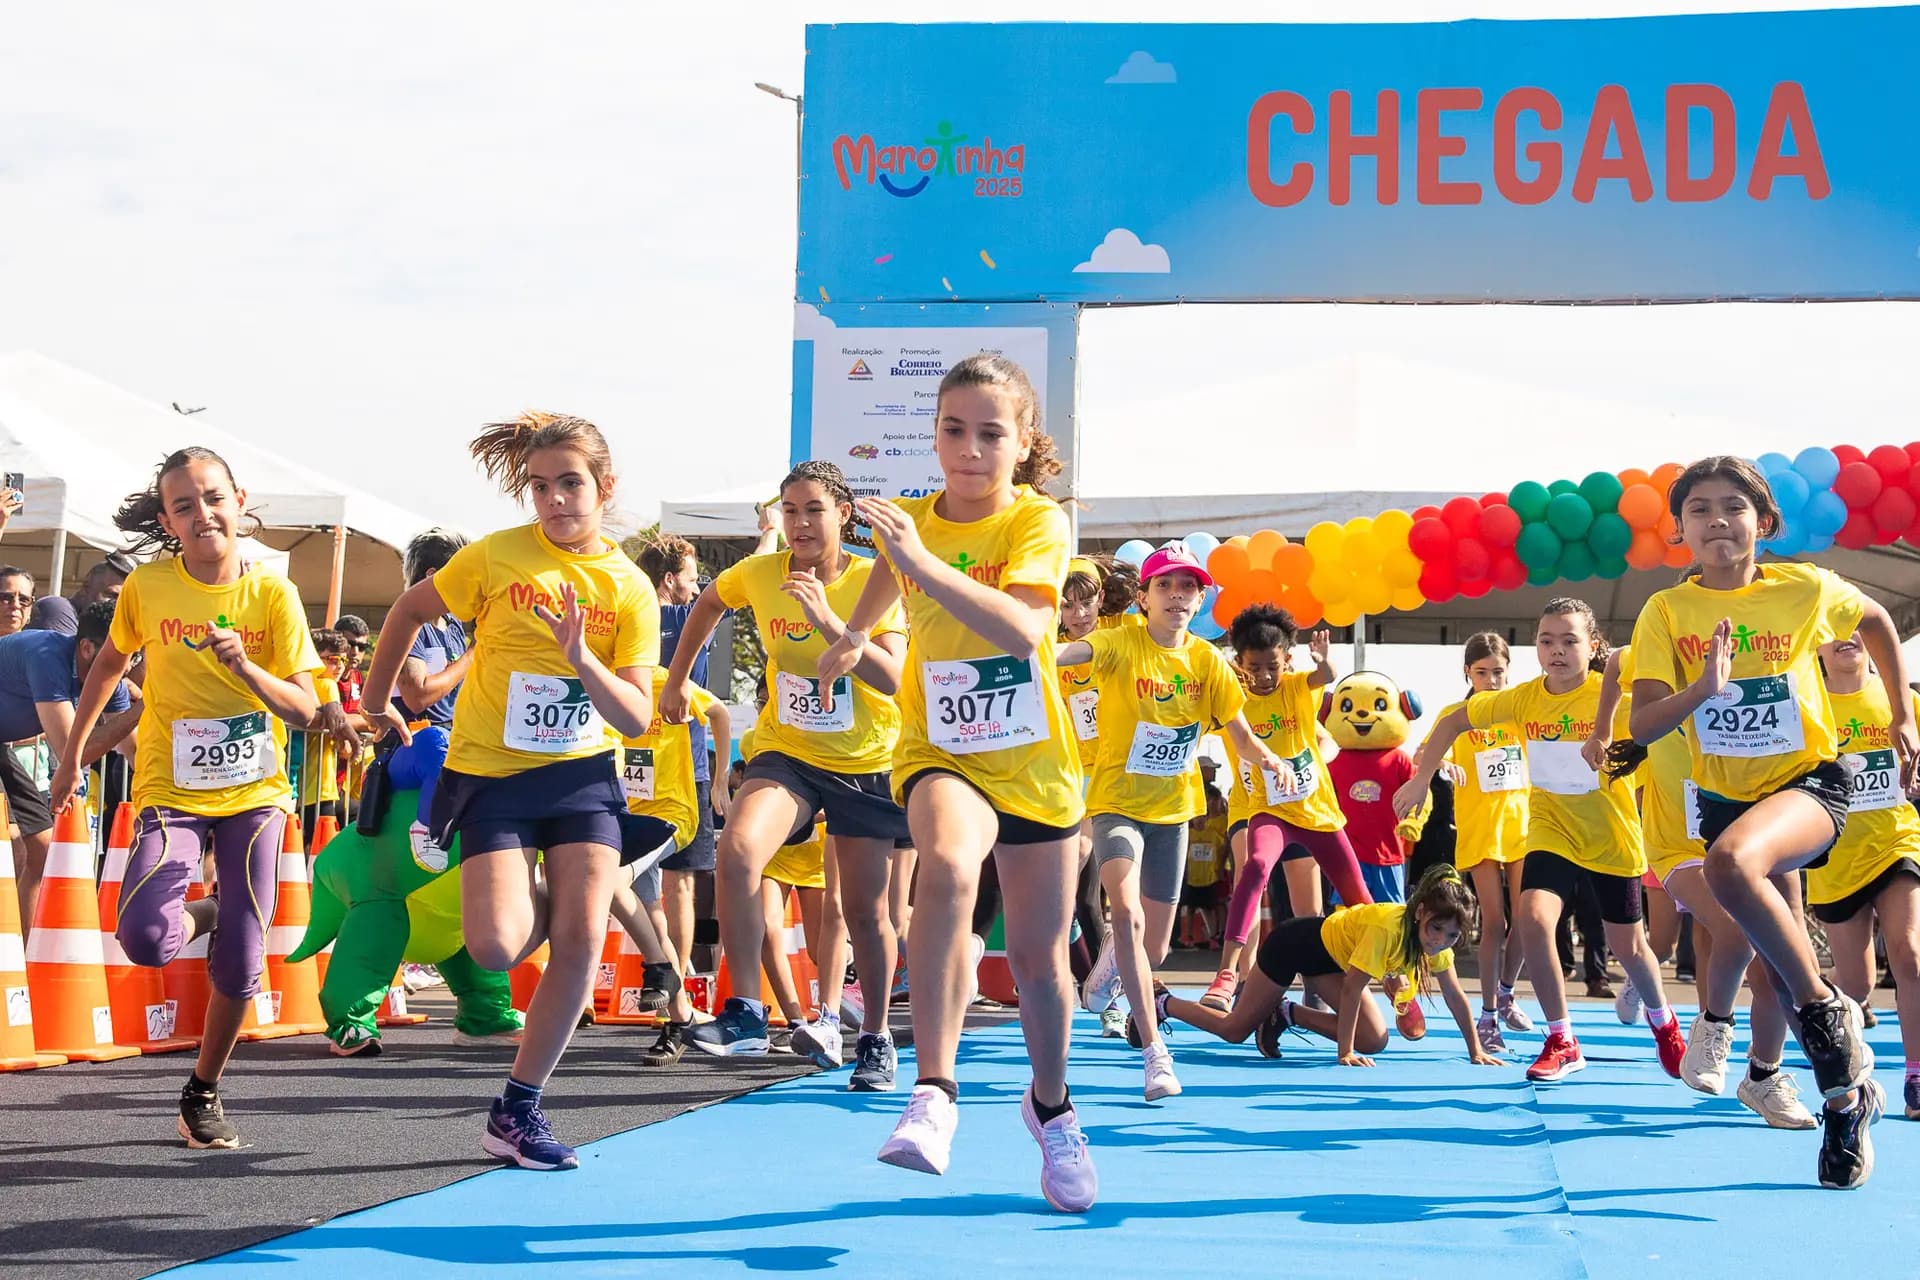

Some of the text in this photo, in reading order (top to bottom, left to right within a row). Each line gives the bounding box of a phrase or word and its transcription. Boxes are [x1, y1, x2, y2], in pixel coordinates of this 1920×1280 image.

[1247, 81, 1831, 208] CHEGADA
[832, 121, 1025, 191] Marotinha
[974, 177, 1023, 198] 2025
[900, 347, 942, 357] Promoção:
[883, 433, 905, 441] Apoio
[907, 433, 917, 441] de
[244, 644, 263, 655] 025
[1763, 651, 1790, 662] 2025
[997, 666, 1010, 675] 10
[1760, 685, 1771, 693] 10
[938, 687, 1017, 725] 3077
[523, 702, 591, 729] 3076
[1704, 704, 1780, 733] 2924
[959, 720, 1001, 736] SOFIA
[988, 731, 1010, 740] CAIXA
[1717, 732, 1772, 740] YASMIN TEIXEIRA
[190, 738, 255, 767] 2993
[1142, 743, 1189, 761] 2981
[1853, 770, 1890, 792] 020
